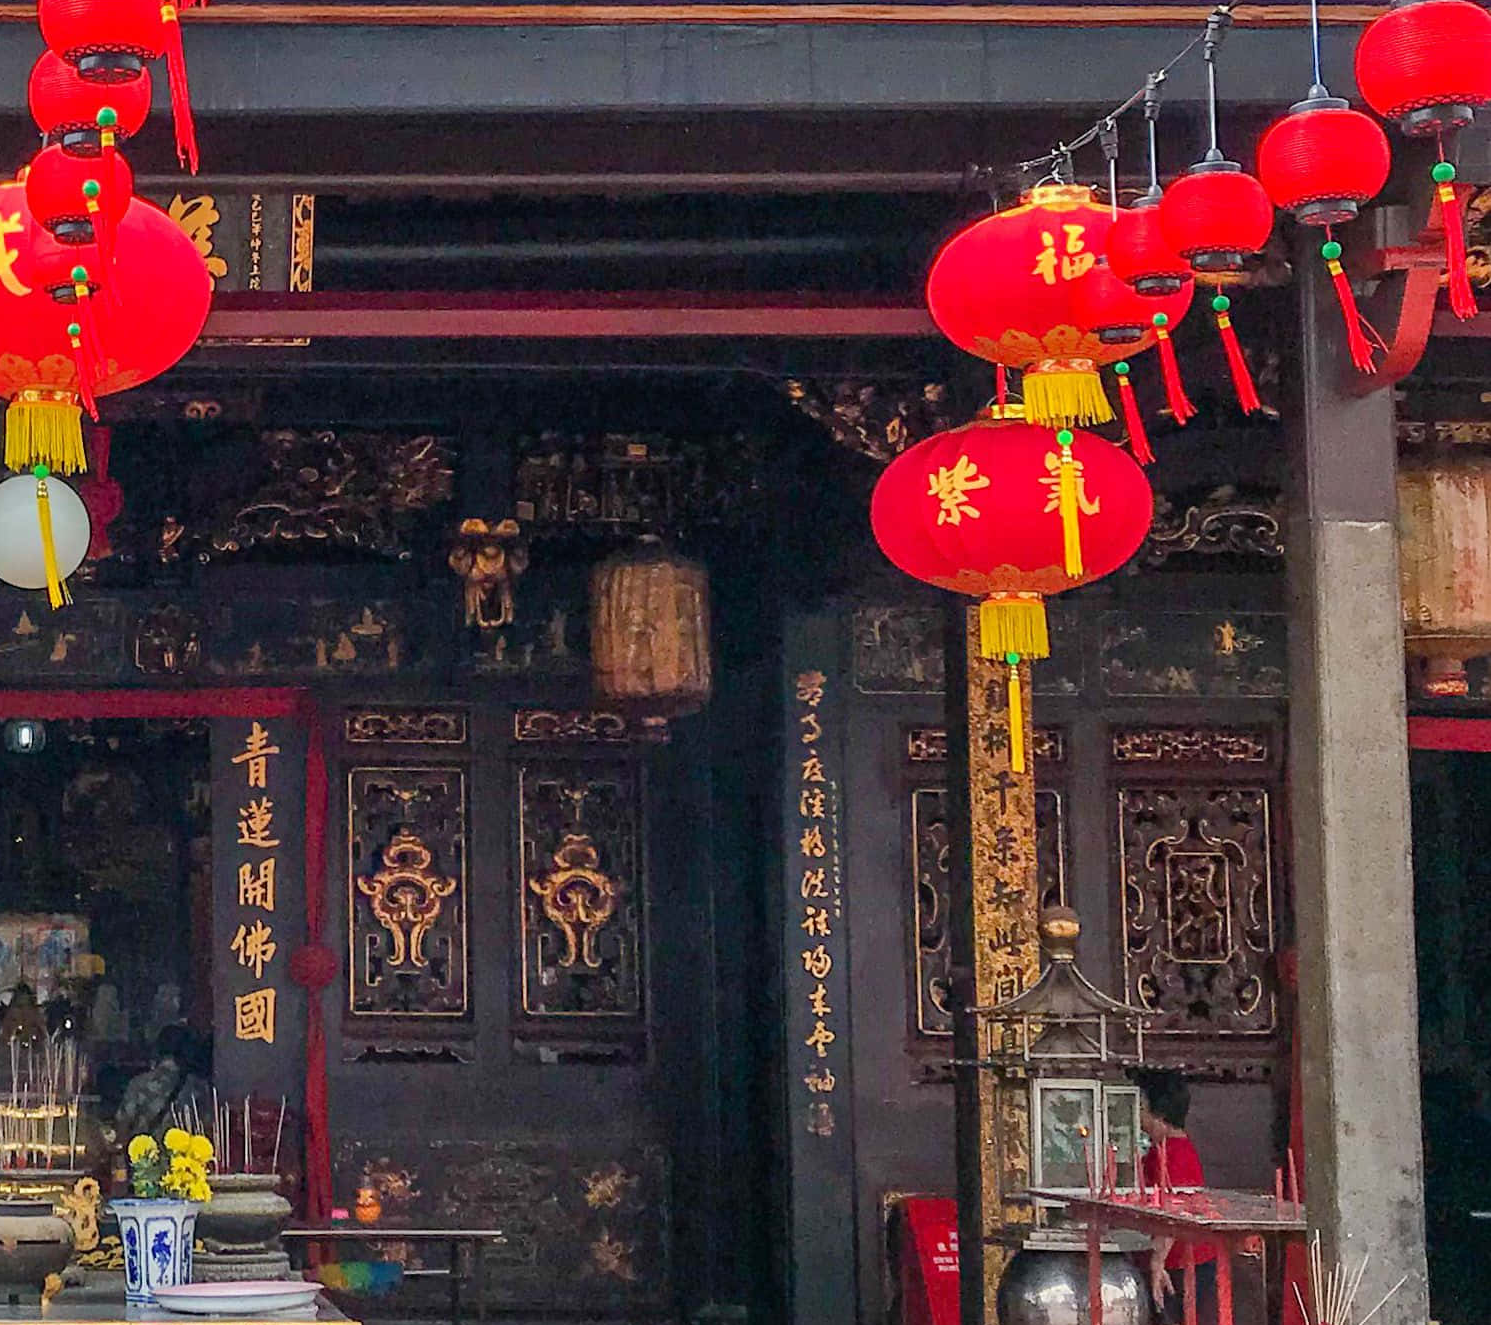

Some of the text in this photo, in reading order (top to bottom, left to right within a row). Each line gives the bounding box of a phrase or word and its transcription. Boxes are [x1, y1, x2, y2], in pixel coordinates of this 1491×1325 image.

[1032, 223, 1096, 285] 福
[927, 452, 1101, 526] 紫氣
[230, 721, 280, 1044] 青蓮開佛國
